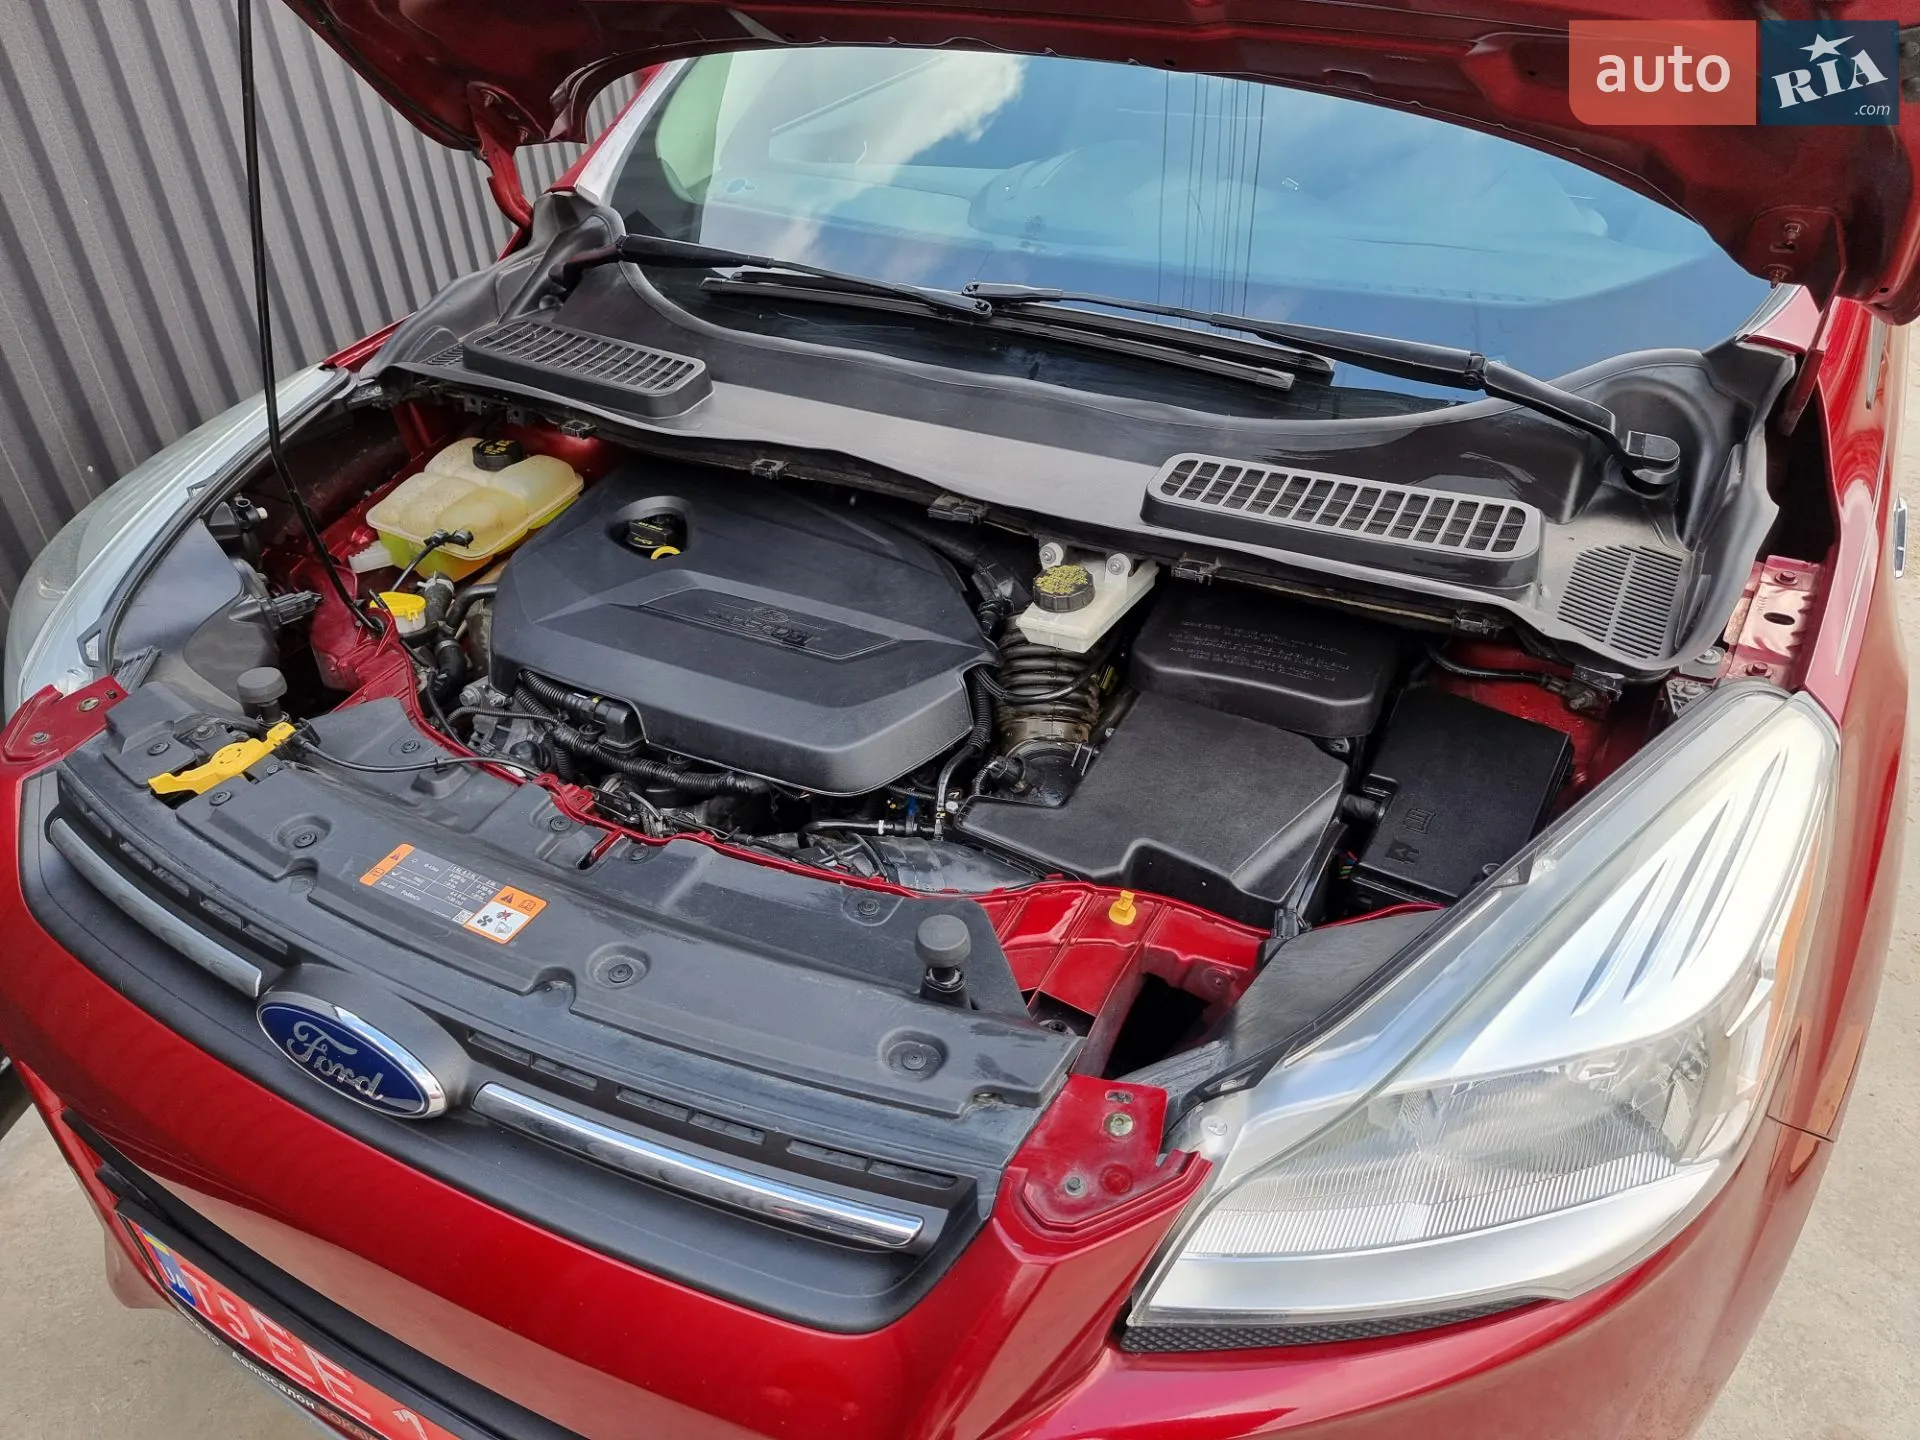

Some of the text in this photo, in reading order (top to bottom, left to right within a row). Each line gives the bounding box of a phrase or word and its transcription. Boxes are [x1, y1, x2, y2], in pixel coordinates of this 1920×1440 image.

[286, 1021, 384, 1100] Ford
[160, 1263, 192, 1296] UA
[232, 1351, 314, 1409] Автосалон
